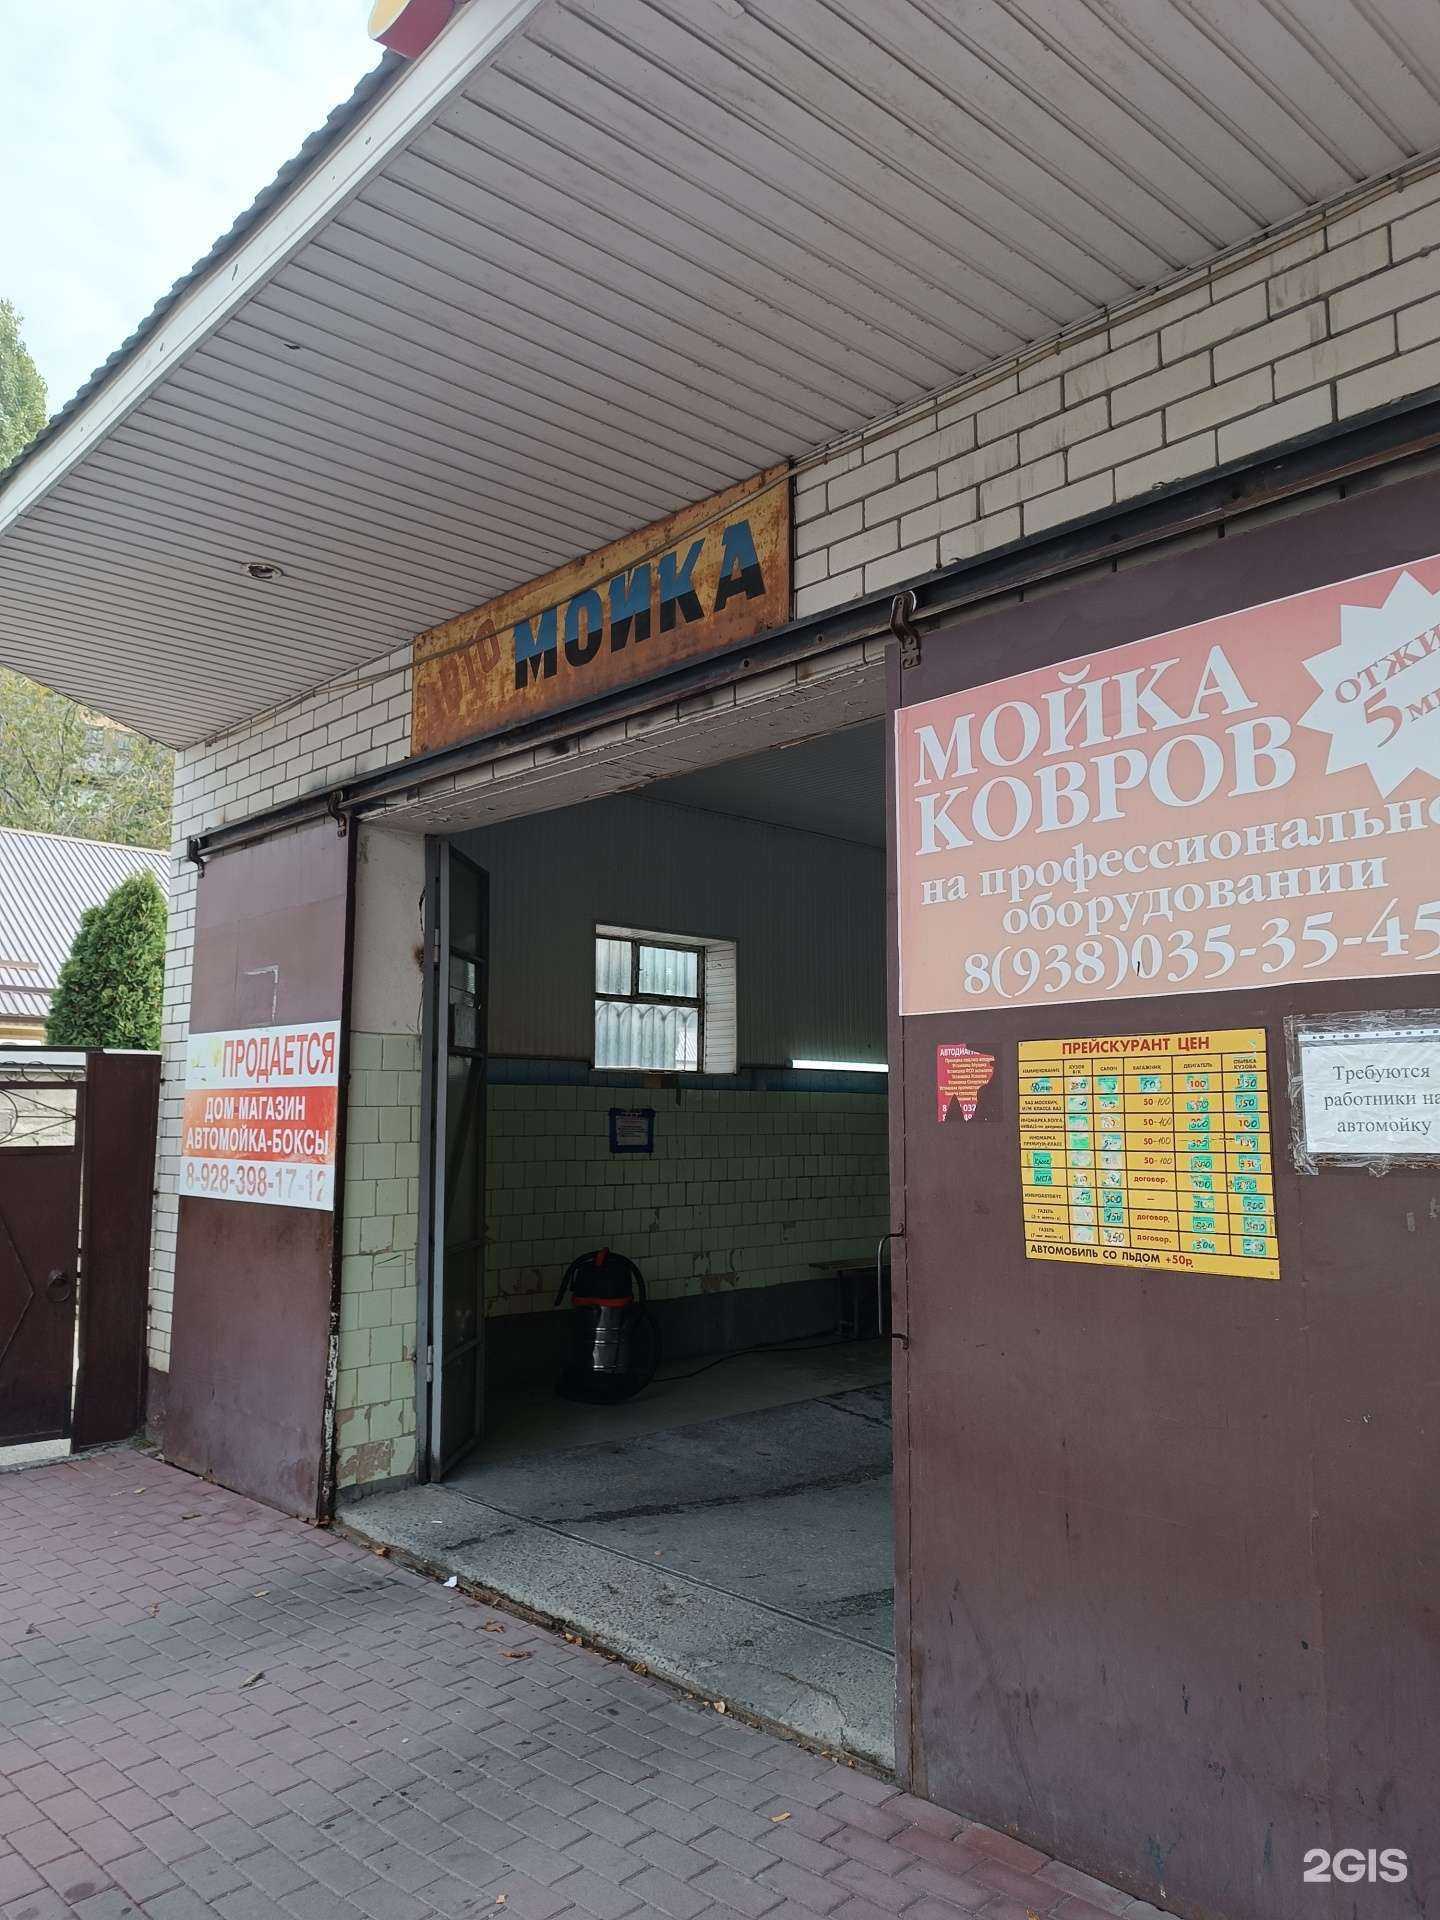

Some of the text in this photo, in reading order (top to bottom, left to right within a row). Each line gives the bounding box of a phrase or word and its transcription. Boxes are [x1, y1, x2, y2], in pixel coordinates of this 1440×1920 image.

[913, 645, 1259, 787] МОЙКА
[1364, 687, 1403, 748] 5
[915, 715, 1297, 856] КОВРОВ
[921, 872, 968, 905] на
[1003, 857, 1389, 936] оборудовании
[963, 898, 1440, 998] 8(938)035-35-45
[222, 1031, 336, 1083] ПРОДАЕТСЯ
[1062, 1036, 1210, 1055] ПРЕЙСКУРАНТ ЦЕН
[1333, 1064, 1430, 1084] Требуются
[238, 1095, 306, 1121] МАГАЗИН
[1324, 1091, 1416, 1110] работники
[185, 1124, 329, 1156] АВТОМОЙКА-БОКСЫ
[1337, 1118, 1432, 1135] автомойку
[1136, 1234, 1172, 1244] договор.
[1031, 1244, 1194, 1268] АВТОМОБИЛЬ СО ЛЬДОМ +50р.
